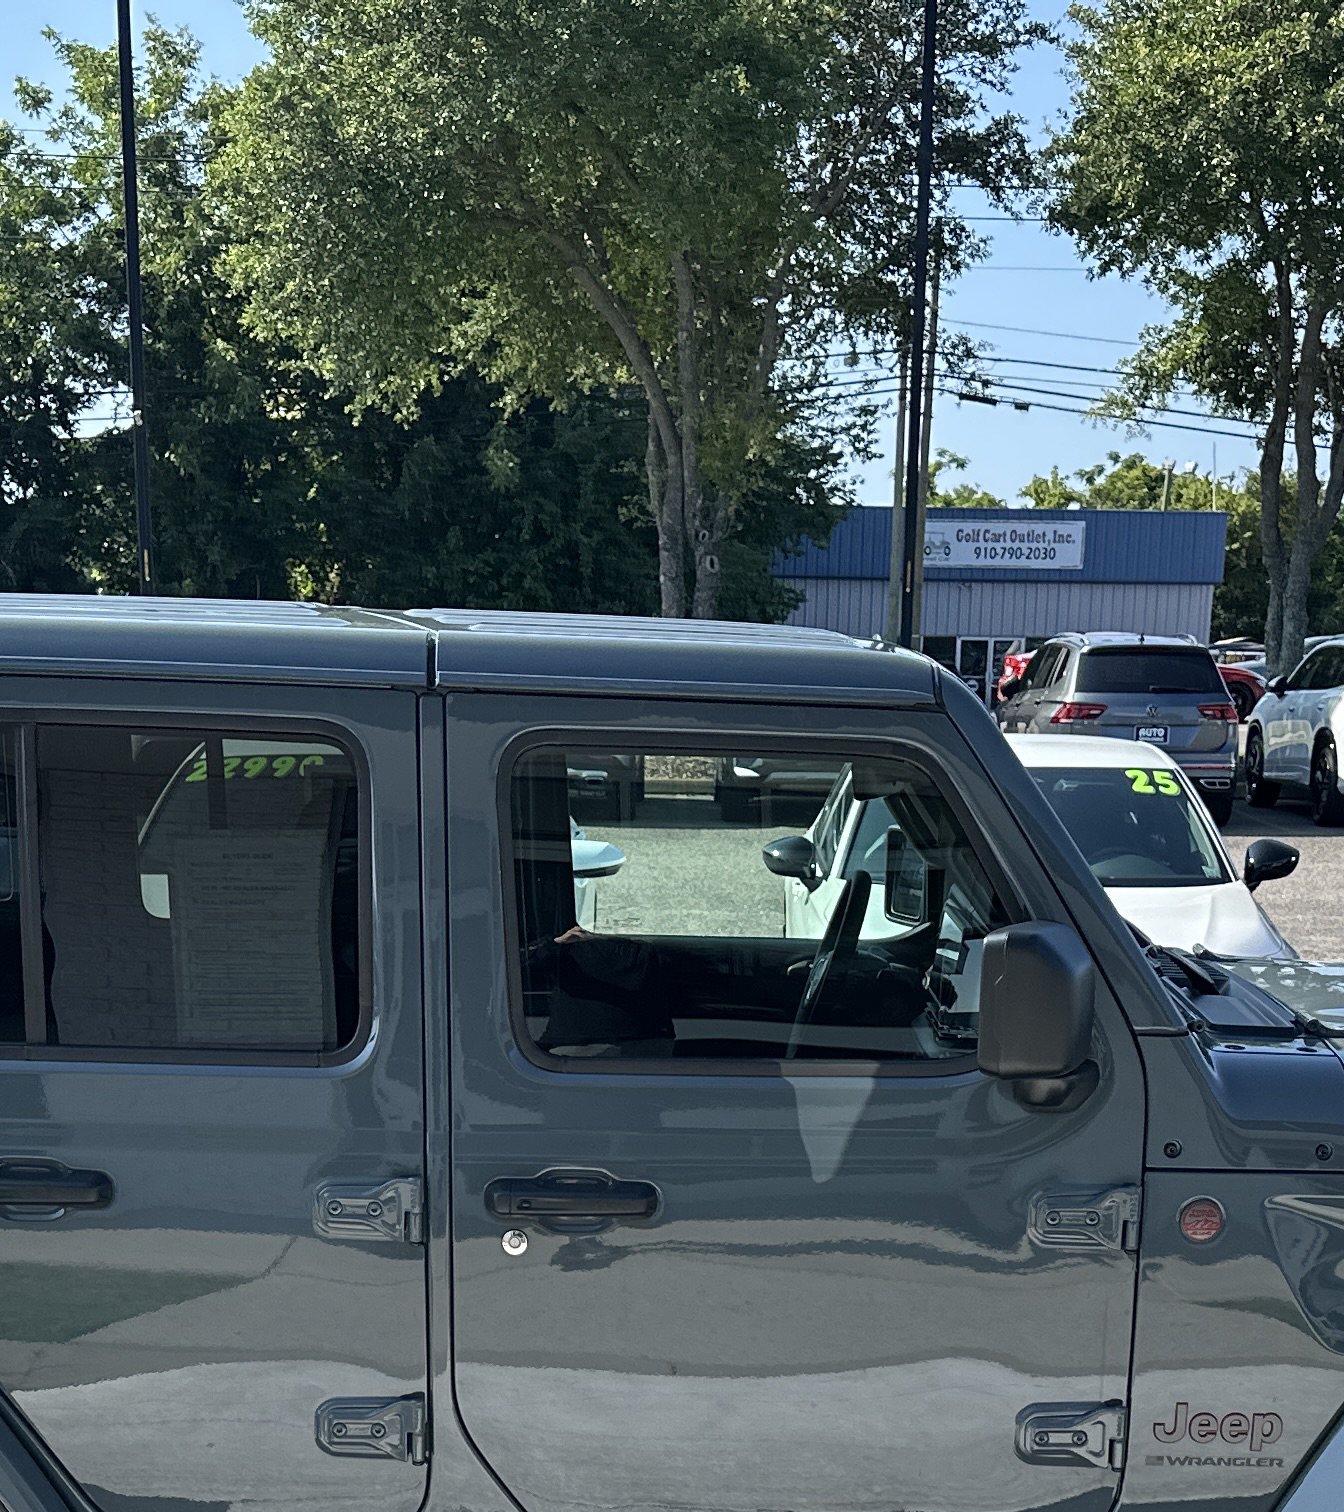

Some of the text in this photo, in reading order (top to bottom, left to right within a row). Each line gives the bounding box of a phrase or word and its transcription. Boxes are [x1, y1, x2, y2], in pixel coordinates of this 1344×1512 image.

[956, 528, 980, 544] Golf
[982, 529, 1007, 544] Cart
[974, 546, 1056, 560] 910-790-2030
[1138, 727, 1165, 737] AUTO
[1124, 769, 1181, 796] 25
[1152, 1402, 1284, 1452] Jeep
[1166, 1456, 1286, 1468] WRANGLER
